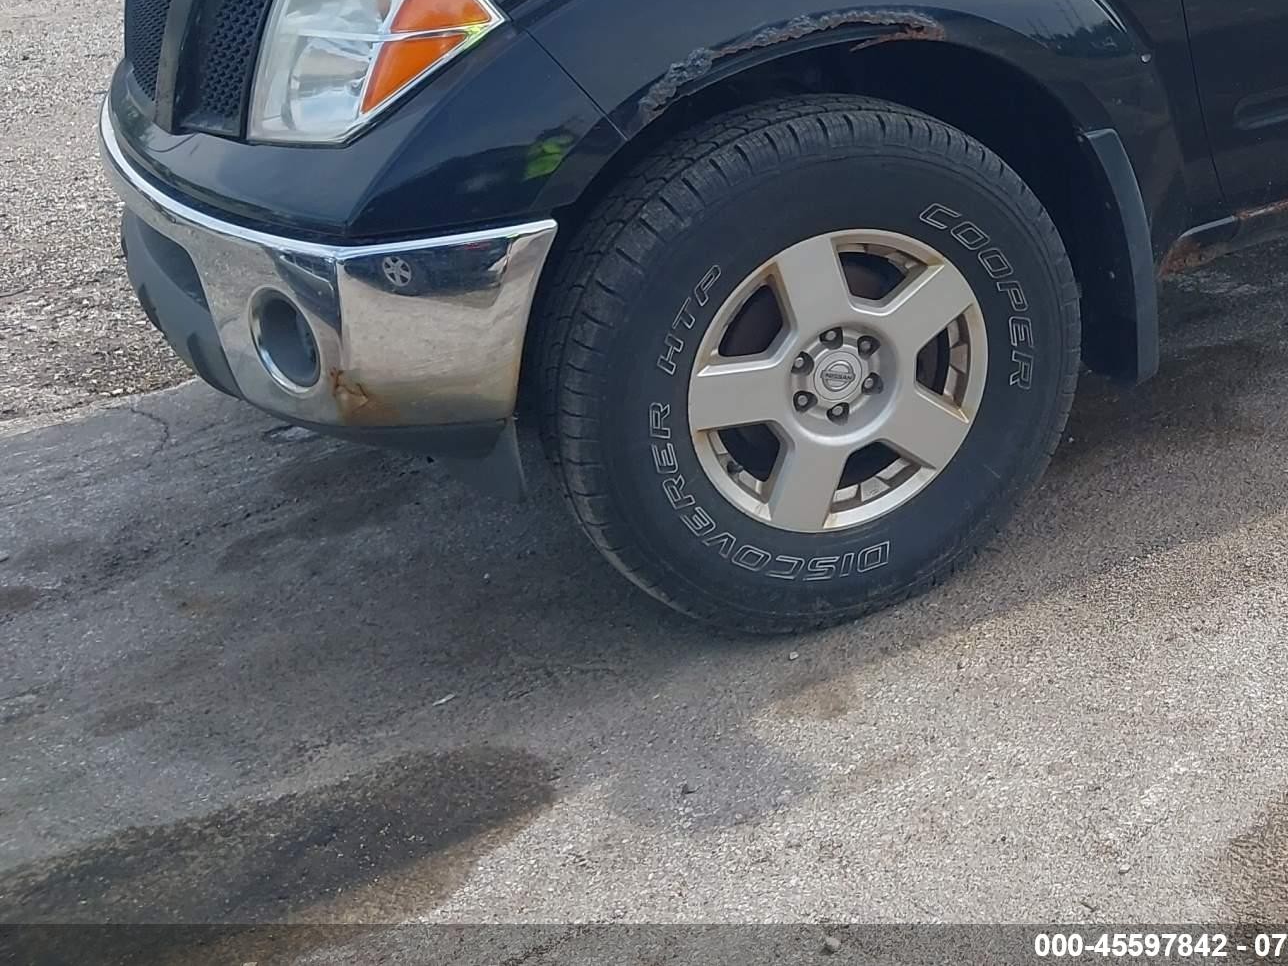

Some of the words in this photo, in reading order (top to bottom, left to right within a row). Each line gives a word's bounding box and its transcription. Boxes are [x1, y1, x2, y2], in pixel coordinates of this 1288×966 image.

[656, 264, 722, 375] HTP
[919, 203, 1034, 390] COOPER
[650, 402, 890, 581] DISCOVERER
